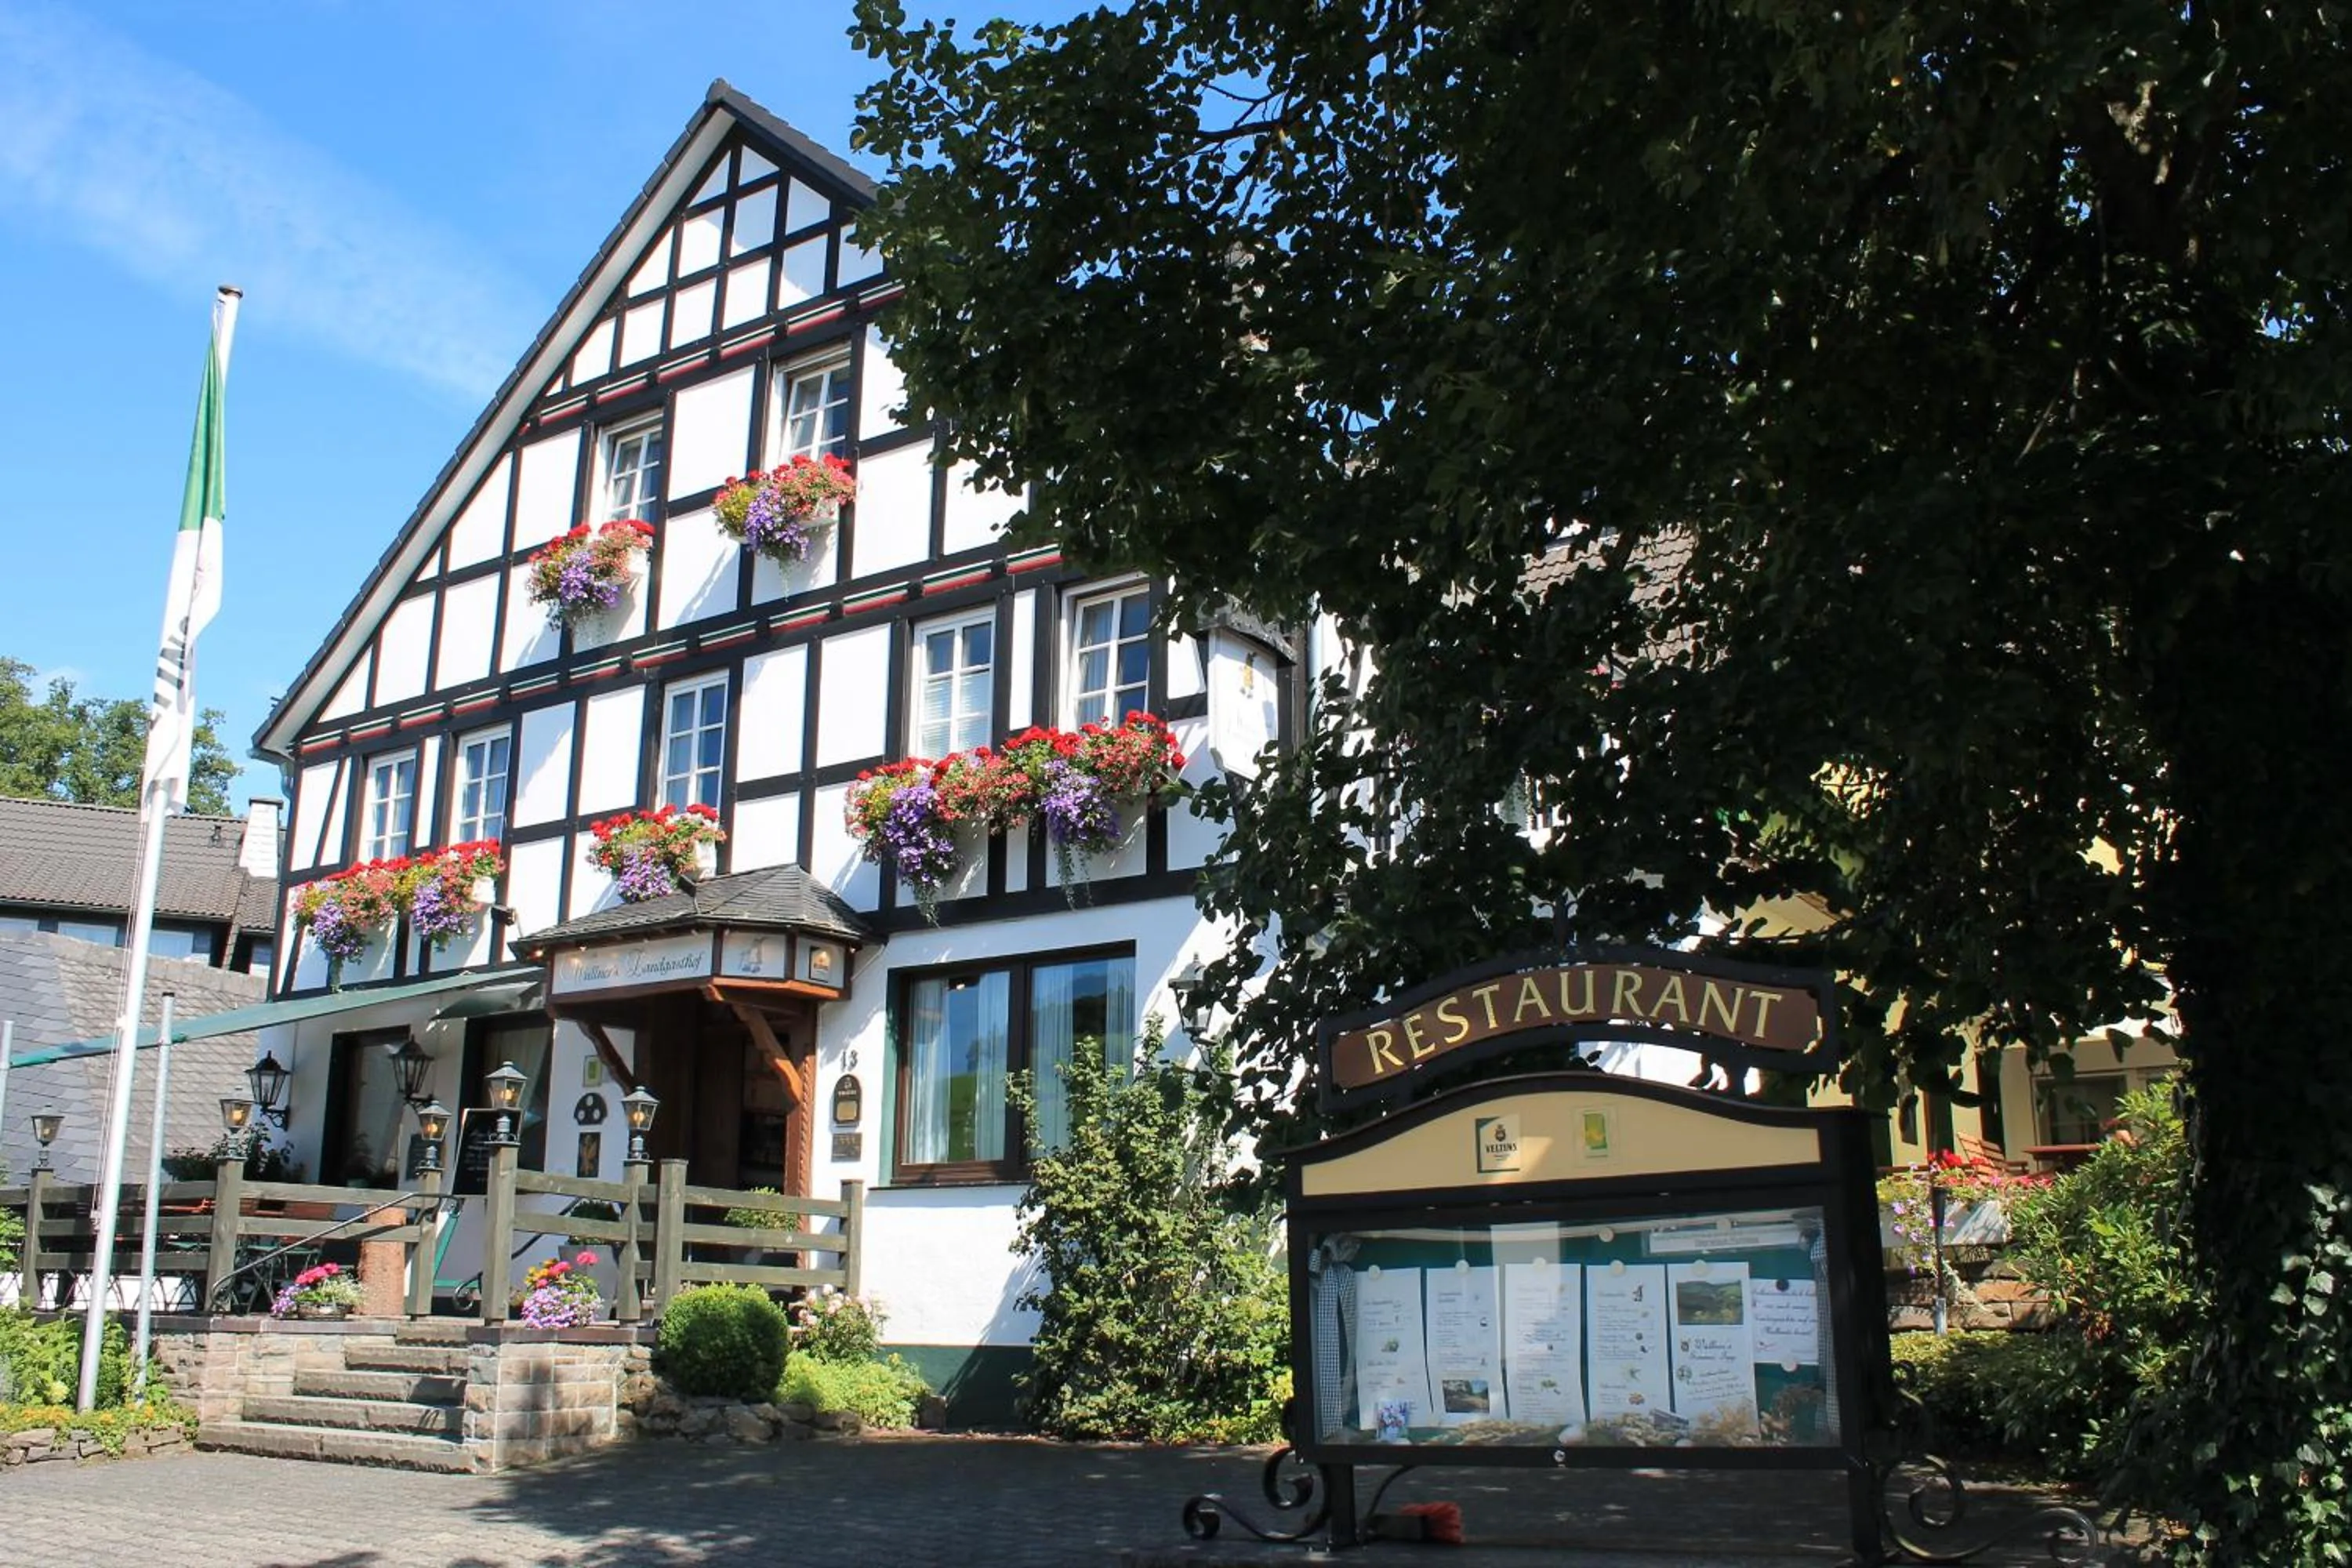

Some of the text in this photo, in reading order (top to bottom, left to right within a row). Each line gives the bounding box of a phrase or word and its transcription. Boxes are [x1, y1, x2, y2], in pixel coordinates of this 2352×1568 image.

[626, 948, 704, 978] Landgasthof
[1367, 969, 1782, 1075] RESTAURANT
[840, 1049, 859, 1073] 13
[1484, 1142, 1518, 1154] VELTINS
